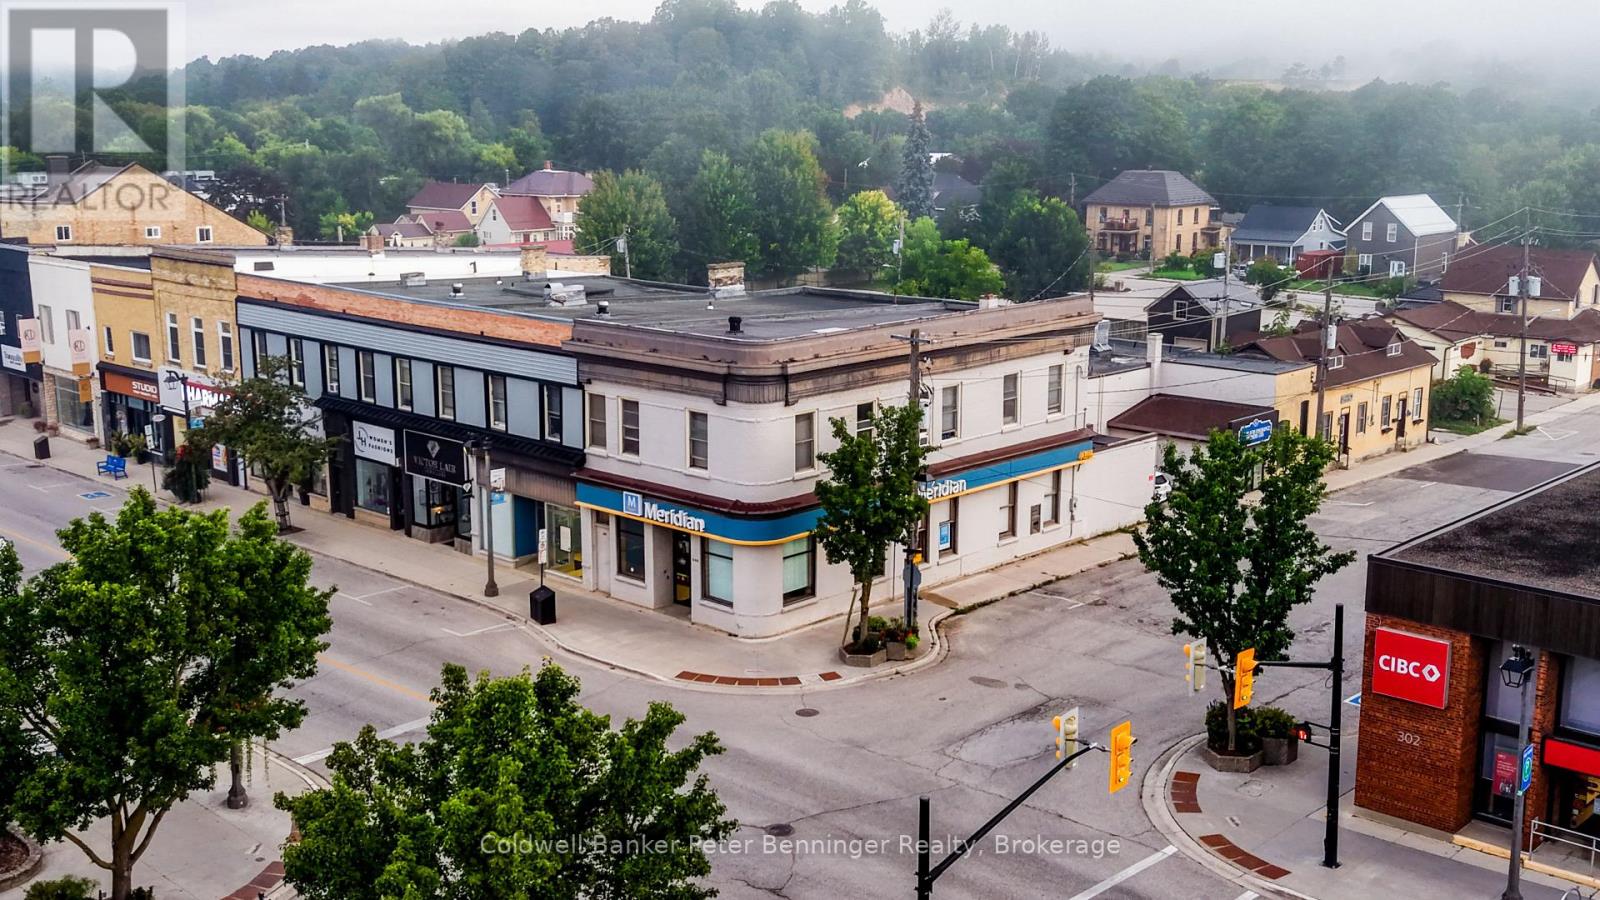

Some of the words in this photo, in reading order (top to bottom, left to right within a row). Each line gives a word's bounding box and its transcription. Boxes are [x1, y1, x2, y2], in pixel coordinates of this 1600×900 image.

[132, 381, 158, 394] STUDIO
[627, 495, 636, 509] M
[644, 501, 706, 532] Meridian
[1379, 655, 1421, 678] CIBC
[1397, 730, 1421, 746] 302
